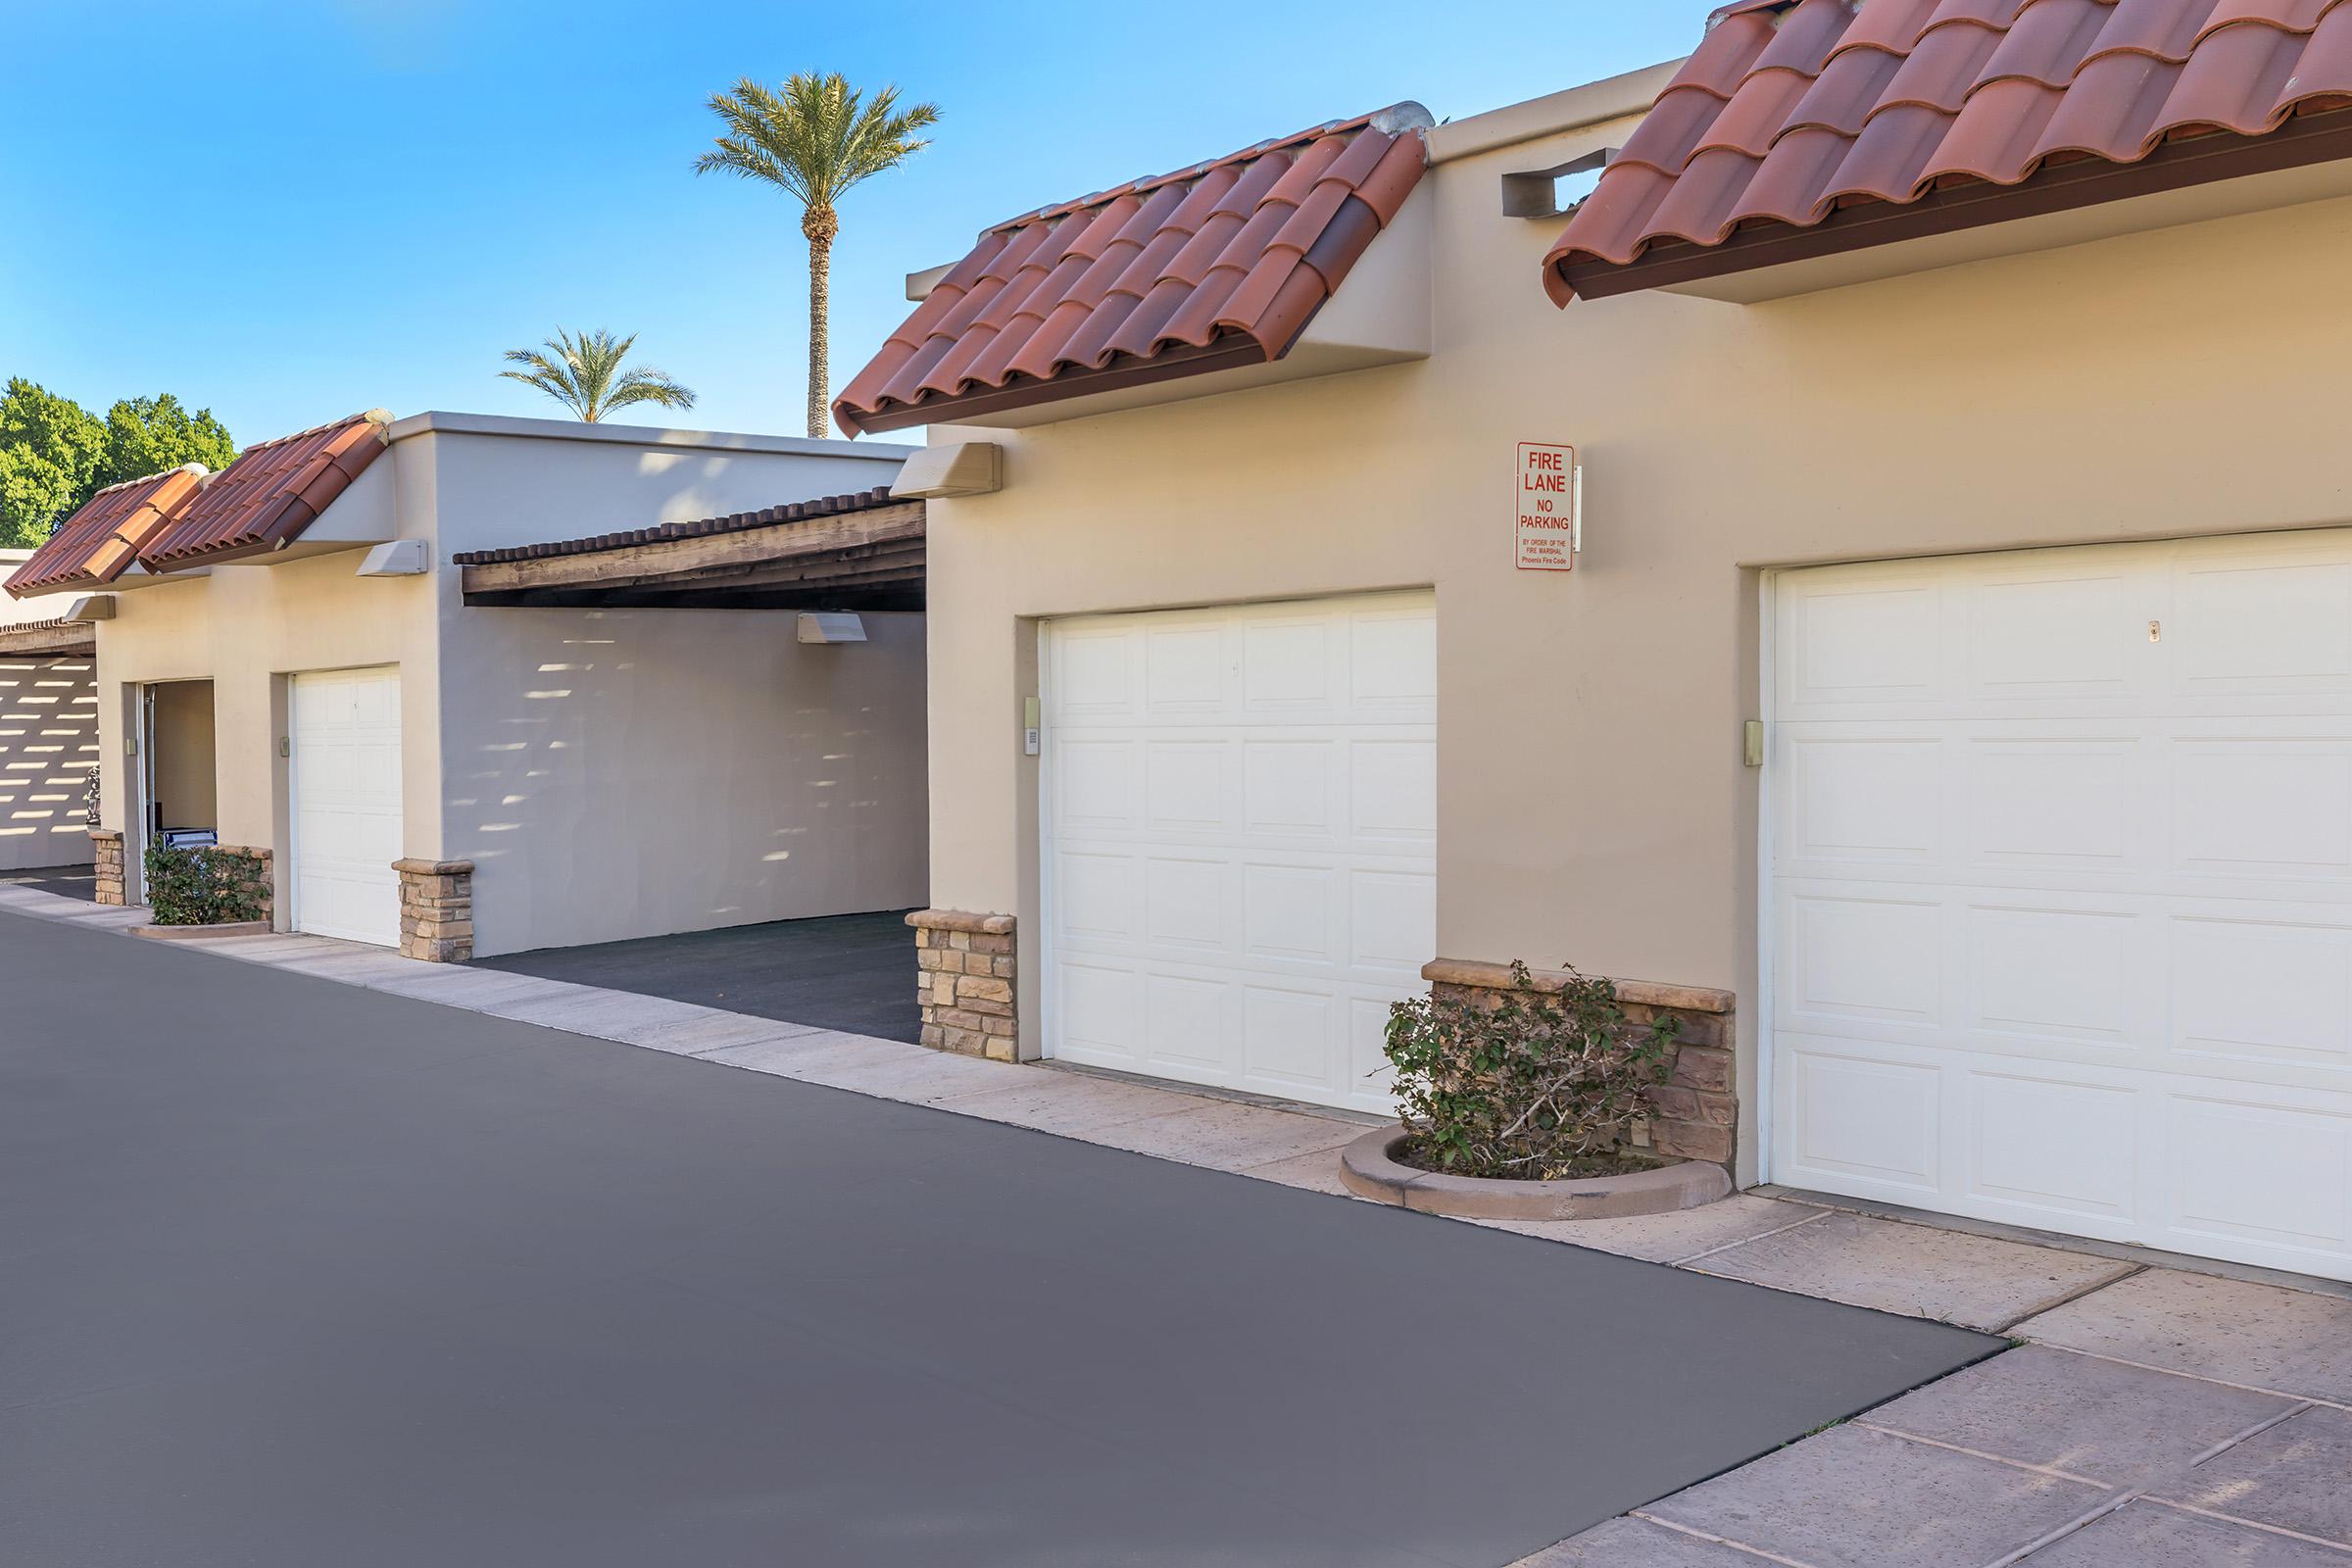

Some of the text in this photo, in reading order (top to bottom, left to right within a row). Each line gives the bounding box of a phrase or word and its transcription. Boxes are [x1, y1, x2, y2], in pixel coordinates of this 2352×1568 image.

[1529, 452, 1562, 470] FIRE
[1525, 473, 1565, 492] LANE
[1538, 499, 1553, 513] NO
[1521, 515, 1569, 530] PARKING
